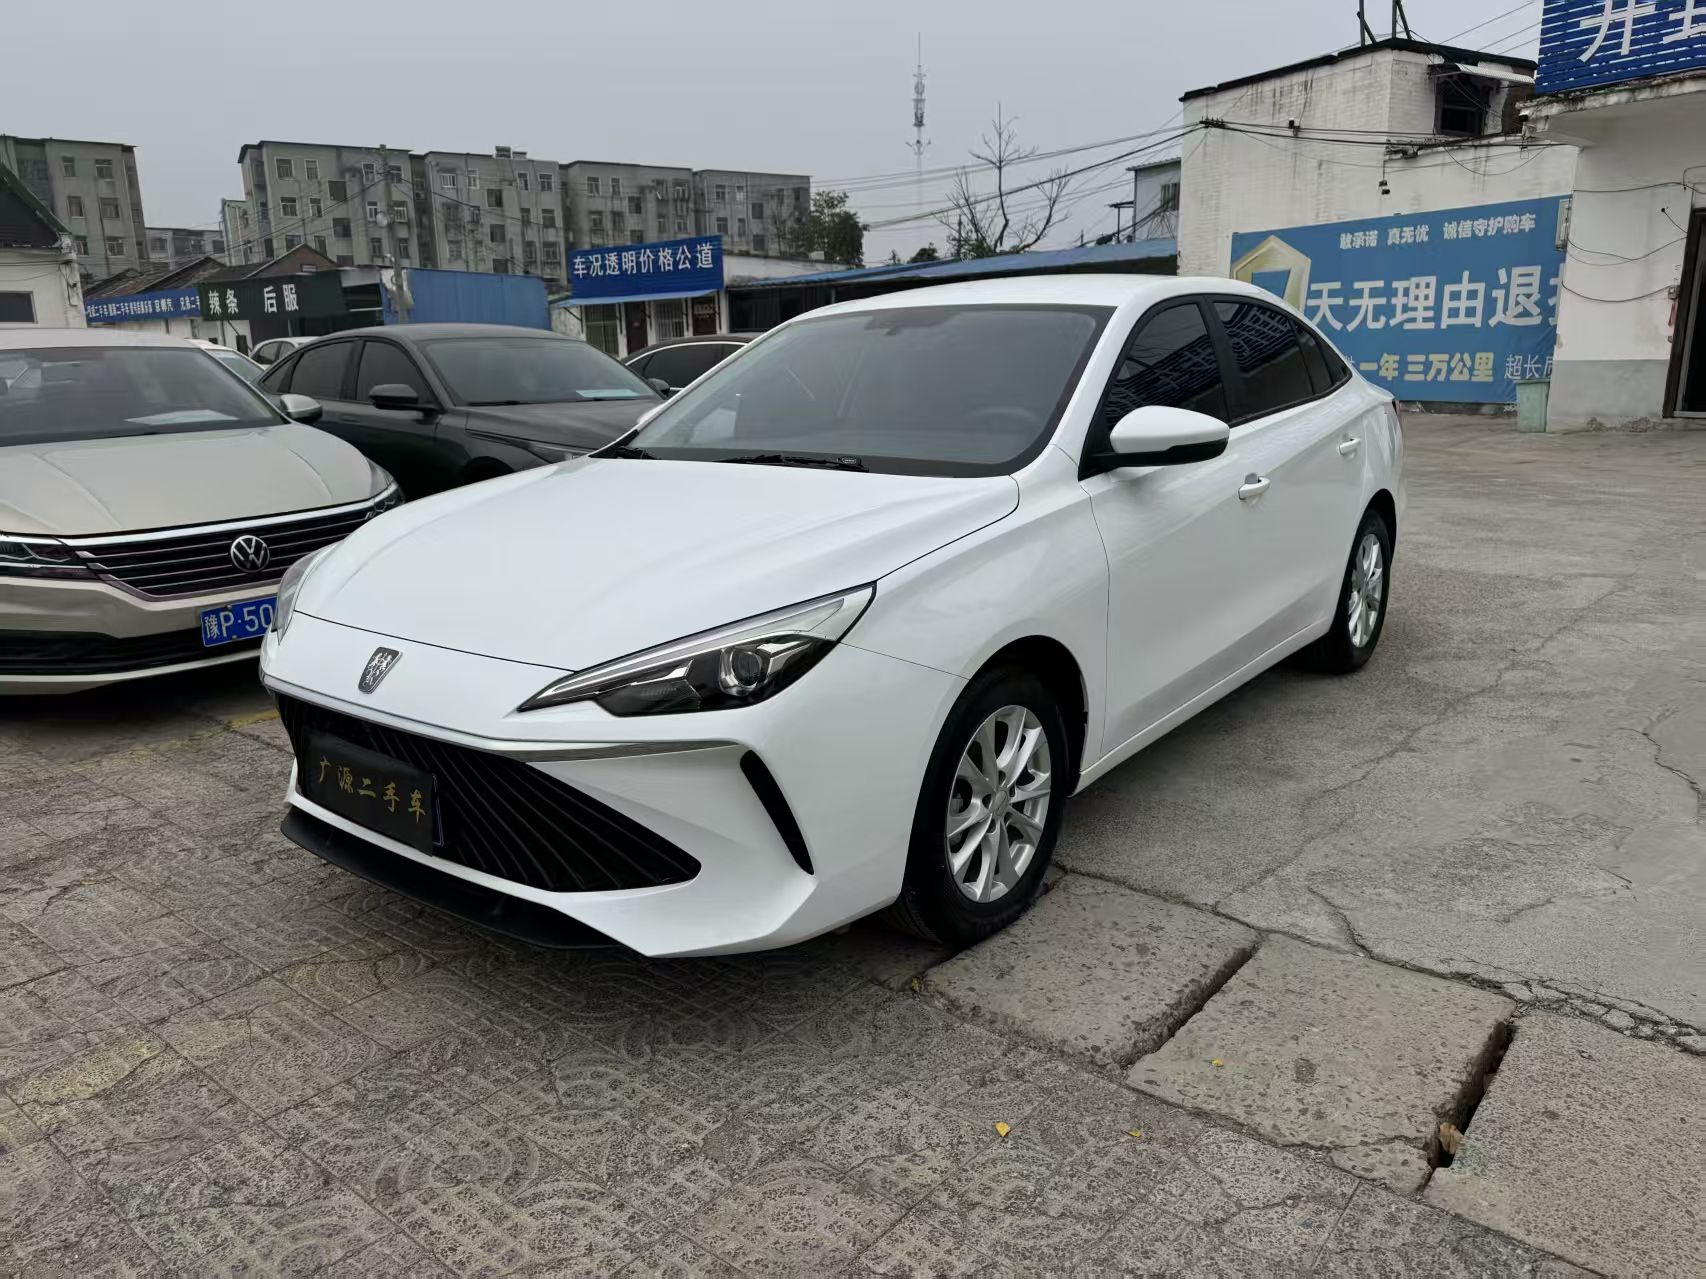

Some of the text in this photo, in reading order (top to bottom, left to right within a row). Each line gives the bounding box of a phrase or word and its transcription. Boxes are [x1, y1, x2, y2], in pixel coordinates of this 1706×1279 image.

[1387, 224, 1430, 246] 真无忧
[1443, 213, 1536, 240] 诚信守护购车
[573, 242, 713, 278] 车况透明价格公道
[263, 283, 299, 313] 后服
[1359, 353, 1400, 381] 一年
[1404, 352, 1494, 382] 三万公里
[319, 755, 426, 823] 广源二手车
